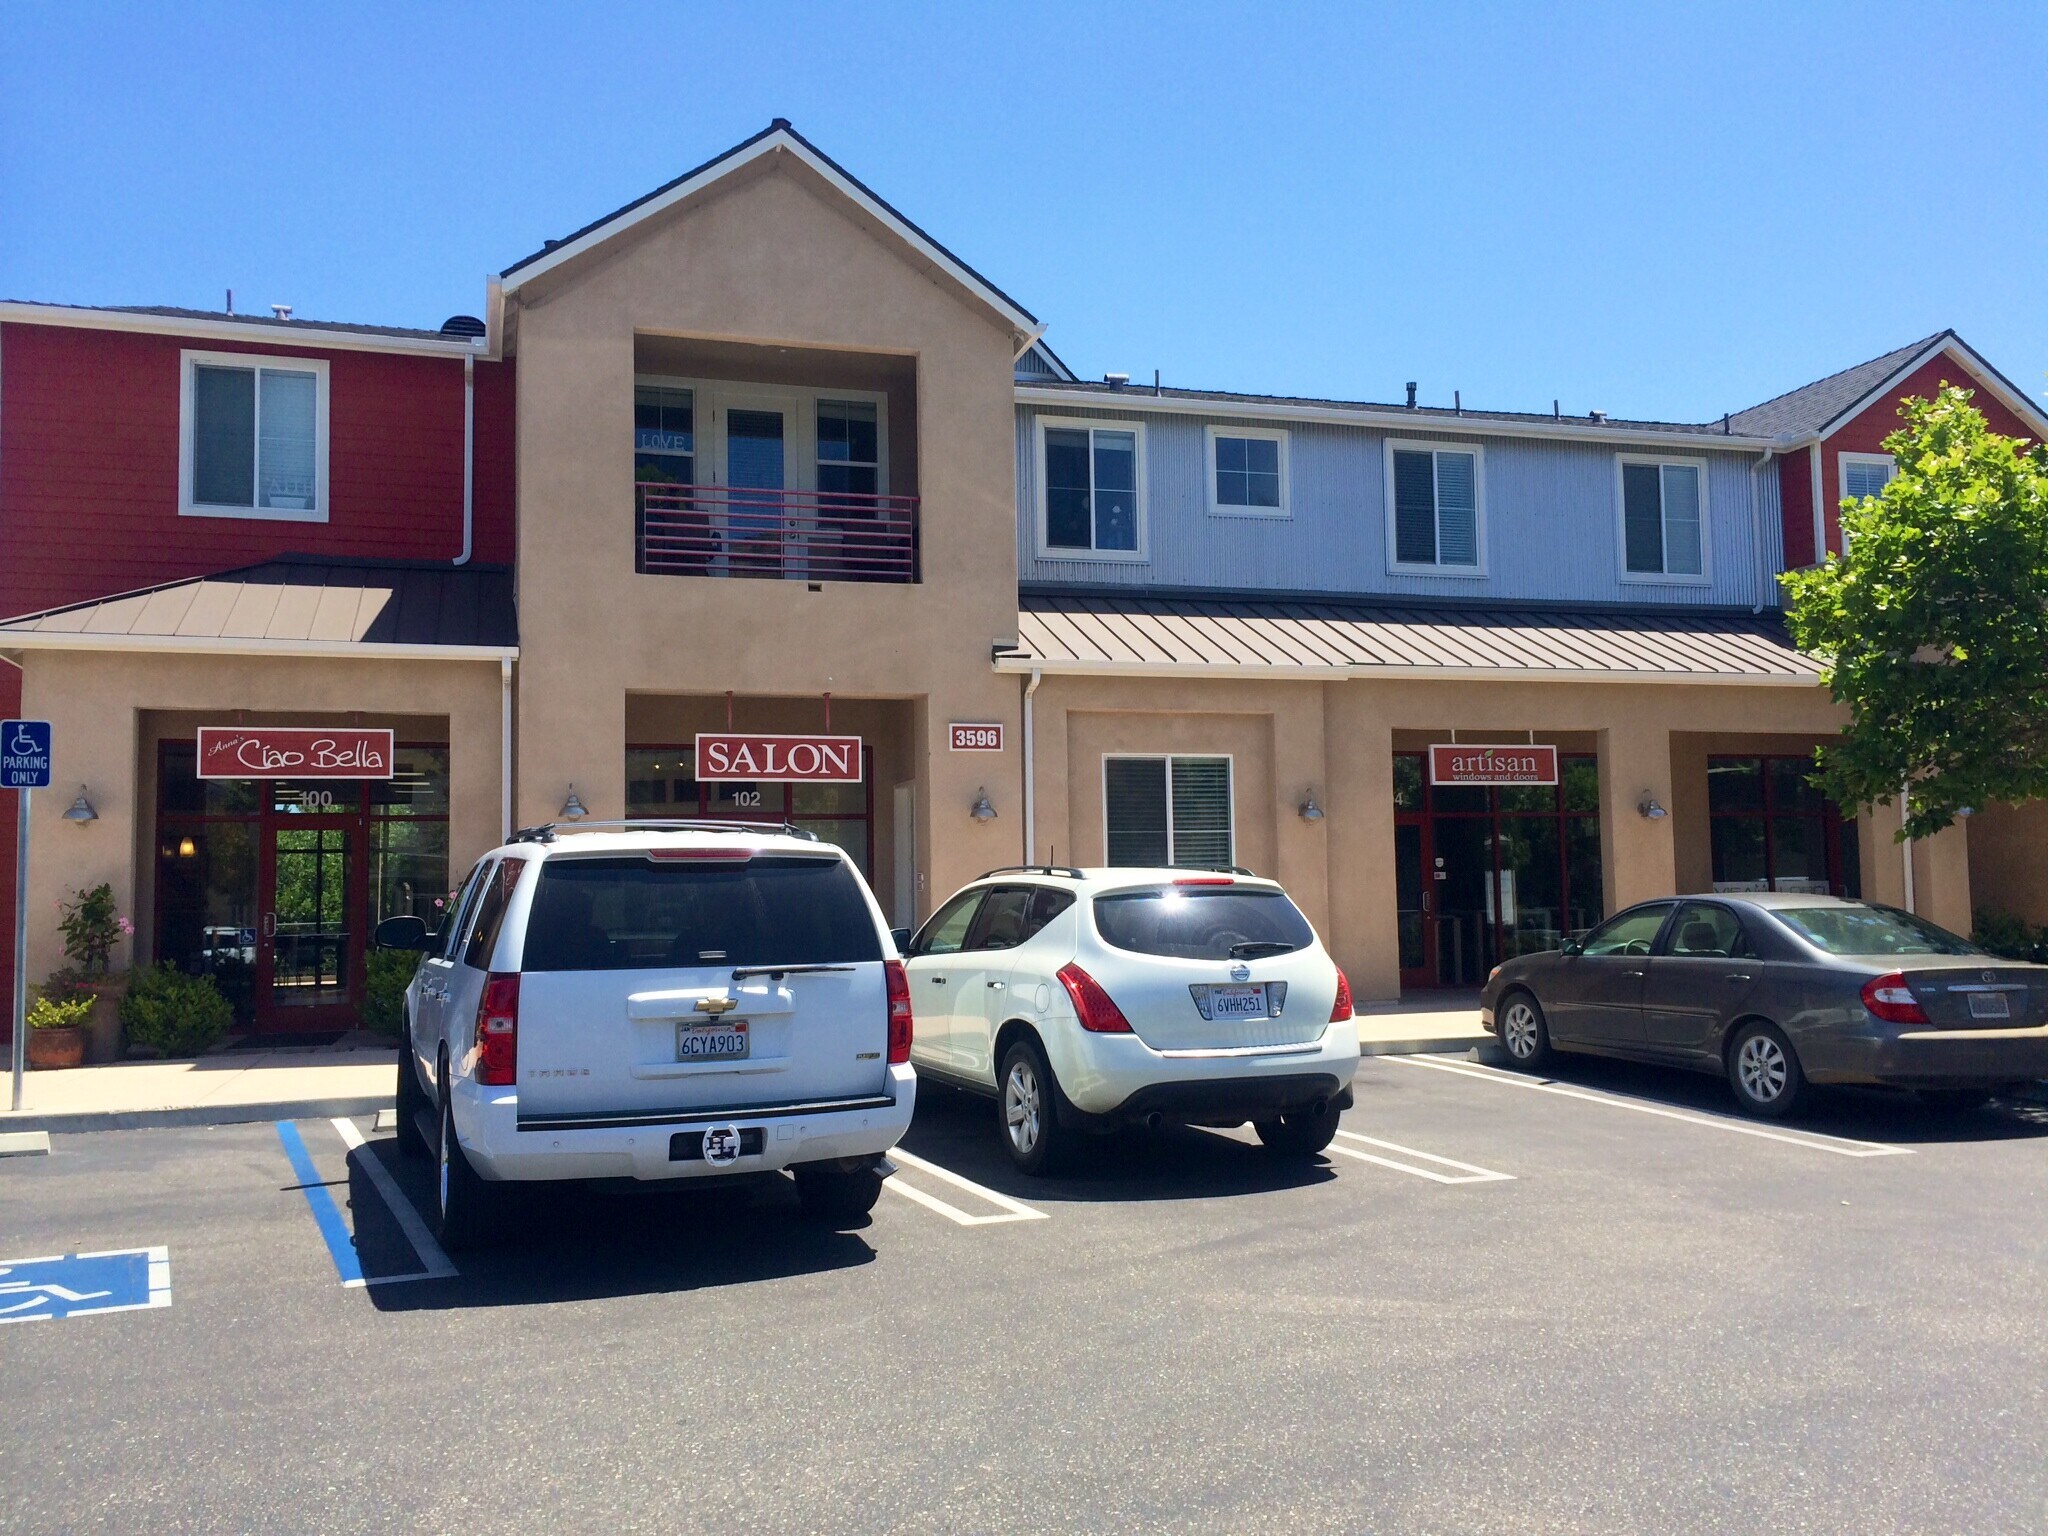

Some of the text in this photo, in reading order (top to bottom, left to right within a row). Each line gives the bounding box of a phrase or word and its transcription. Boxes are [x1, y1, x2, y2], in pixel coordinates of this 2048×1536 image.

[641, 434, 685, 449] LOVE
[208, 734, 245, 757] Anna's
[955, 729, 997, 746] 3596
[3, 756, 48, 769] PARKING
[237, 739, 383, 770] Ciao Bella
[707, 742, 851, 774] SALON
[1451, 748, 1537, 772] artisan
[11, 771, 39, 784] ONLY
[1452, 773, 1538, 781] windows and doors
[300, 790, 333, 807] 100
[732, 791, 761, 807] 102
[1217, 997, 1262, 1012] 6VHH251
[681, 1034, 744, 1054] 6CYA903
